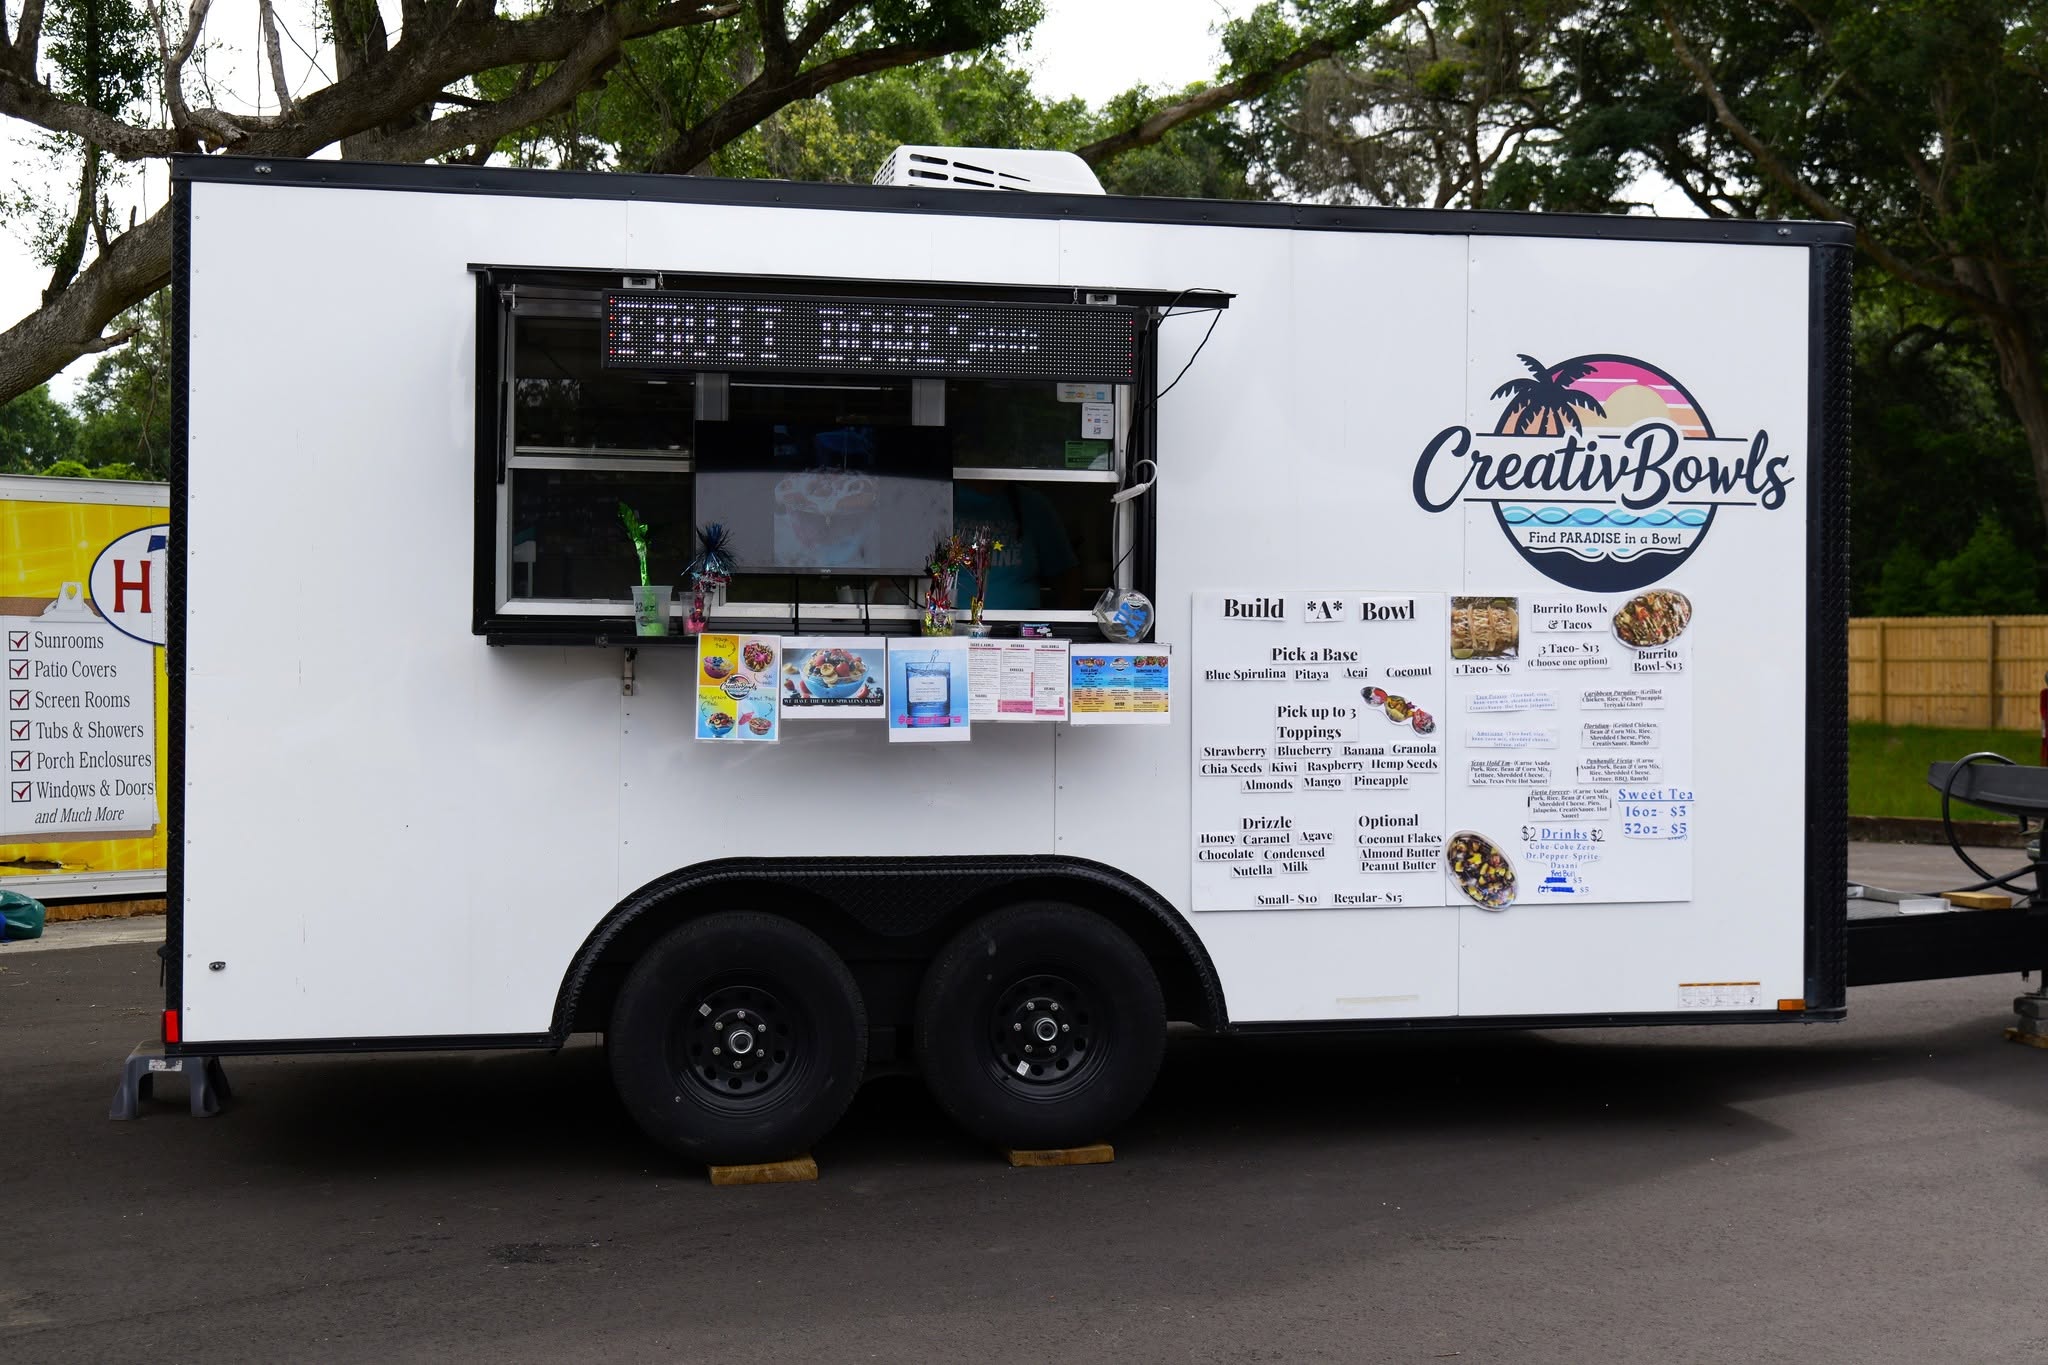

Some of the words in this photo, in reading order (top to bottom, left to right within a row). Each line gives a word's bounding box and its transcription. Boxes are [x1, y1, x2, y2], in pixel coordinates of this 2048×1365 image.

[1412, 422, 1794, 513] CreativBowls
[1529, 532, 1556, 542] Find
[1560, 532, 1620, 543] PARADISE
[1625, 534, 1636, 543] in
[1652, 533, 1681, 544] Bowl
[1224, 598, 1284, 618] Build
[1362, 600, 1414, 620] Bowl
[1533, 603, 1573, 614] Burrito
[1576, 603, 1608, 614] Bowls
[1548, 620, 1558, 629] &
[1561, 620, 1592, 629] Tacos
[34, 631, 103, 649] Sunrooms
[1272, 647, 1306, 661] Pick
[1310, 651, 1318, 661] a
[1323, 648, 1358, 661] Base
[1638, 648, 1678, 660] Burrito
[34, 660, 67, 677] Patio
[72, 660, 116, 677] Covers
[1496, 664, 1510, 673] $6
[1528, 659, 1559, 667] (Choose
[1578, 657, 1608, 667] option)
[1206, 670, 1231, 680] Blue
[1234, 668, 1286, 680] Spirulina
[1295, 669, 1328, 680] Pitaya
[1344, 668, 1368, 678] Acai
[1386, 666, 1432, 677] Coconut
[35, 690, 80, 708] Screen
[85, 690, 130, 708] Rooms
[1278, 705, 1307, 718] Pick
[1311, 708, 1328, 720] up
[1333, 707, 1346, 718] to
[1350, 708, 1356, 719] 3
[36, 722, 68, 739] Tubs
[72, 722, 83, 738] &
[88, 721, 144, 738] Showers
[1277, 725, 1341, 740] Toppings
[1204, 746, 1267, 757] Strawberry
[1278, 745, 1332, 756] Blueberry
[1344, 746, 1384, 755] Banana
[1392, 744, 1436, 754] Granola
[37, 752, 74, 769] Porch
[80, 751, 152, 768] Enclosures
[1202, 764, 1227, 774] Chia
[1230, 763, 1262, 773] Seeds
[1272, 762, 1297, 772] Kiwi
[1308, 760, 1364, 772] Raspberry
[1372, 760, 1404, 770] Hemp
[1407, 759, 1438, 769] Seeds
[36, 781, 95, 798] Windows
[100, 780, 110, 796] &
[116, 780, 153, 796] Doors
[1244, 779, 1293, 790] Almonds
[1304, 778, 1341, 788] Mango
[1354, 775, 1408, 787] Pineapple
[1618, 789, 1662, 799] Sweet
[1668, 789, 1693, 799] Tea
[35, 808, 58, 824] and
[60, 807, 91, 822] Much
[95, 807, 124, 821] More
[1670, 806, 1686, 818] $3
[1243, 816, 1292, 829] Drizzle
[1358, 814, 1418, 829] Optional
[1671, 823, 1686, 834] $5
[1201, 834, 1236, 844] Honey
[1243, 833, 1290, 845] Caramel
[1300, 832, 1332, 842] Agave
[1358, 835, 1404, 844] Coconut
[1408, 833, 1442, 843] Flakes
[1521, 826, 1537, 842] $2
[1541, 828, 1588, 839] Drinks
[1591, 828, 1605, 842] $2
[1199, 849, 1254, 860] Chocolate
[1264, 848, 1325, 860] Condensed
[1360, 848, 1403, 858] Almond
[1407, 848, 1440, 858] Butter
[1233, 865, 1272, 876] Nutella
[1282, 861, 1308, 872] Milk
[1362, 862, 1399, 871] Peanut
[1403, 861, 1436, 870] Butter
